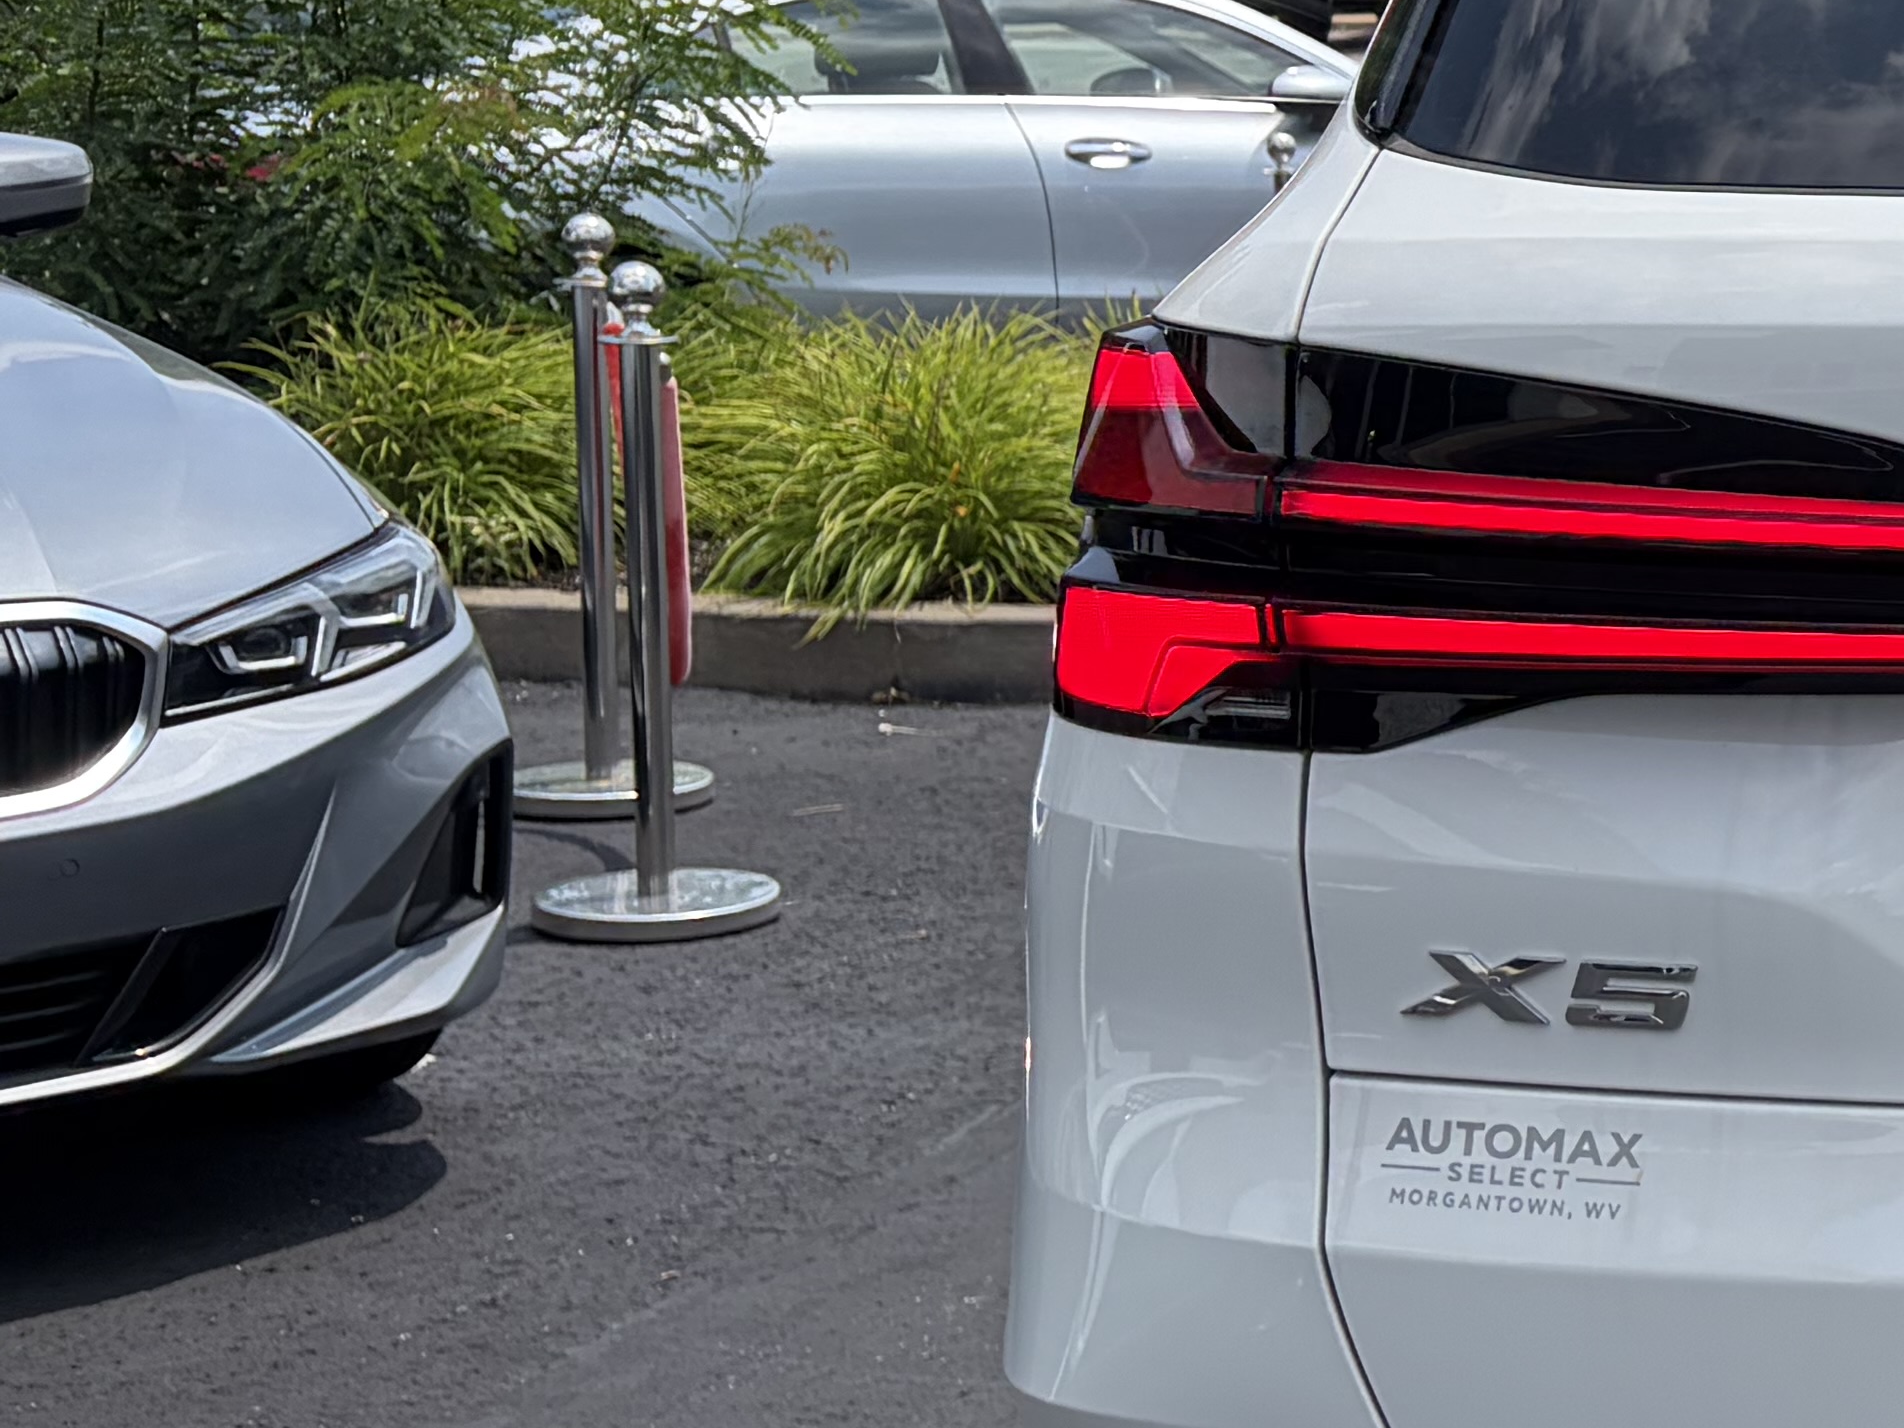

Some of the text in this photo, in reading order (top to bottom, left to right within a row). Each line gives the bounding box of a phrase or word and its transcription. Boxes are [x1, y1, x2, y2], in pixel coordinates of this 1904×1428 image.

[1399, 948, 1699, 1031] X5
[1385, 1116, 1644, 1170] AUTOMAX
[1447, 1161, 1571, 1190] SELECT
[1388, 1187, 1622, 1221] MORGANTOWN, WV
